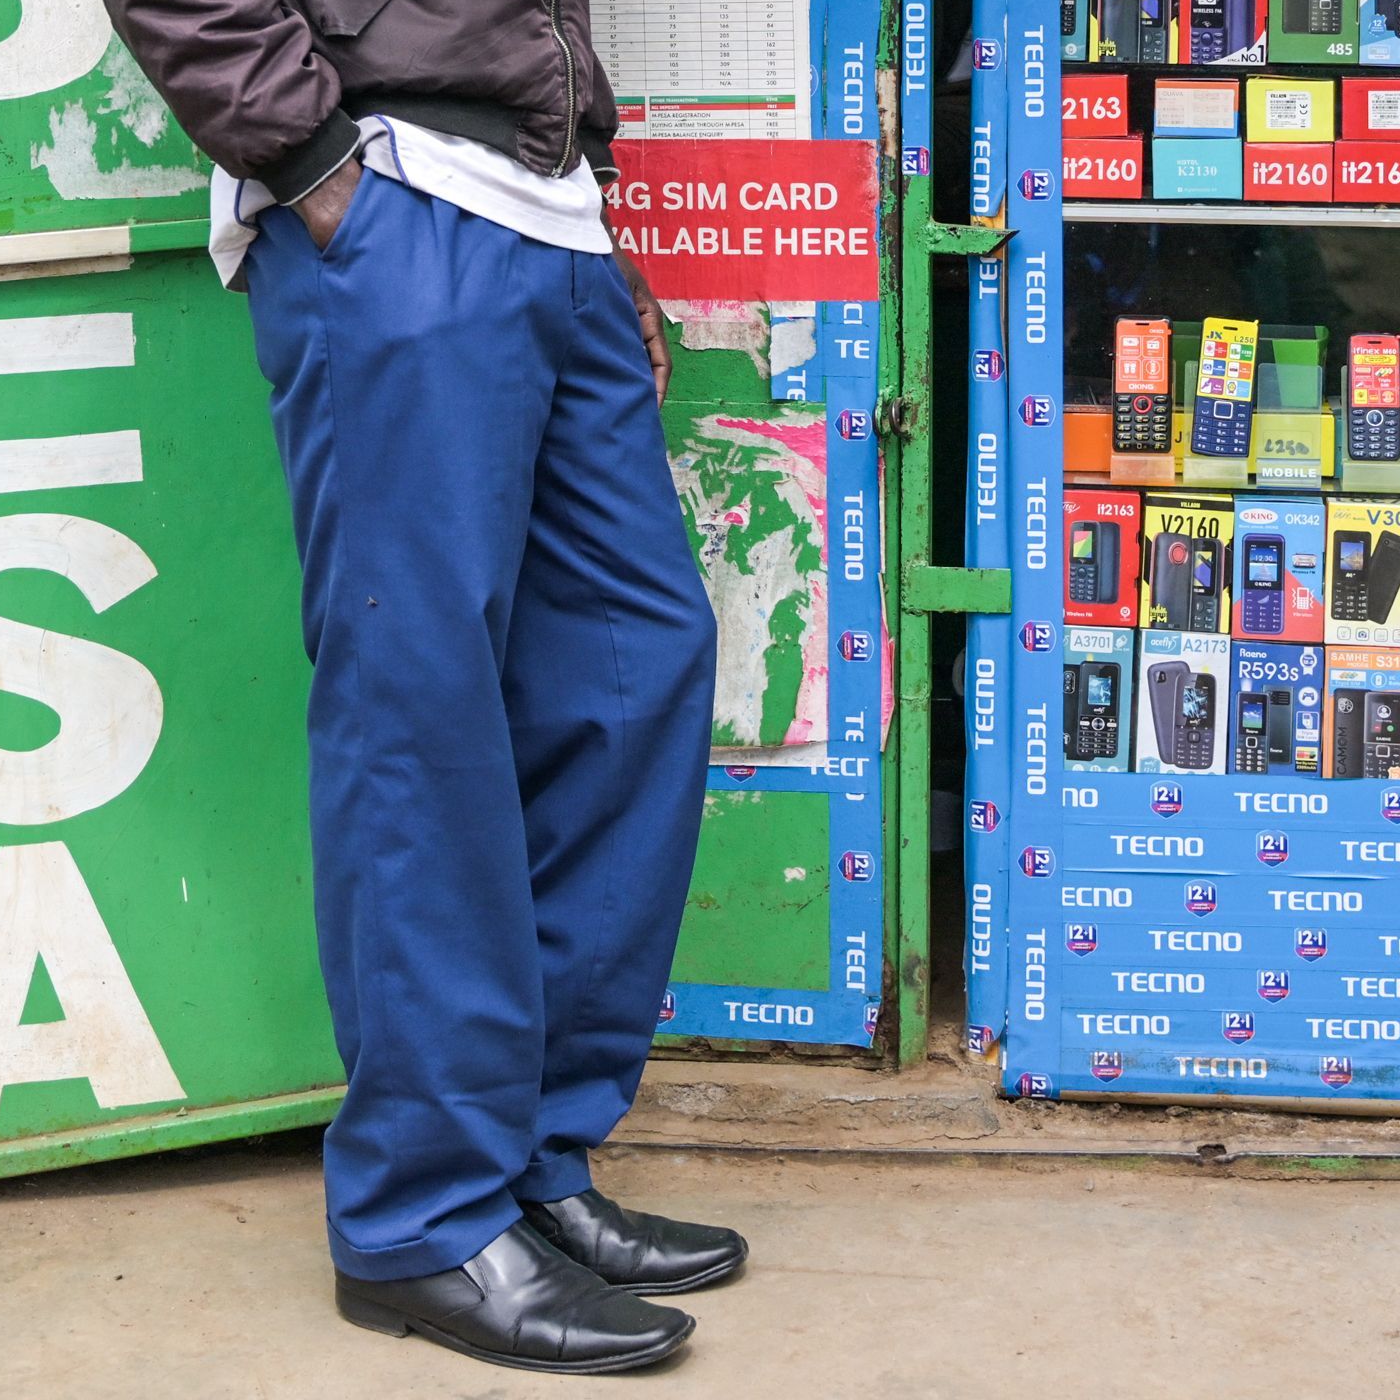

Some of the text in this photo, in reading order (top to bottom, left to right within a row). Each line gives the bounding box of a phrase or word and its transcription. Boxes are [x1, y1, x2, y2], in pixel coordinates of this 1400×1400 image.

[905, 2, 927, 96] TECNO
[1326, 43, 1353, 56] 485
[1063, 158, 1137, 182] it2160
[1177, 164, 1218, 178] K2130
[1252, 162, 1328, 186] it2160
[661, 180, 728, 211] SIM
[739, 180, 839, 211] CARD
[611, 225, 869, 257] AILABLE HERE
[978, 432, 997, 526] TECNO
[1262, 468, 1317, 479] MOBILE
[1096, 503, 1135, 517] it2163
[845, 490, 865, 581] TECNO
[1026, 477, 1046, 570] TECNO
[1073, 634, 1111, 649] A3701
[1182, 639, 1227, 654] A2173
[1239, 662, 1299, 681] R593s
[1234, 791, 1328, 816] TECNO
[1110, 834, 1204, 858] TECNO
[723, 1001, 813, 1026] TECNO
